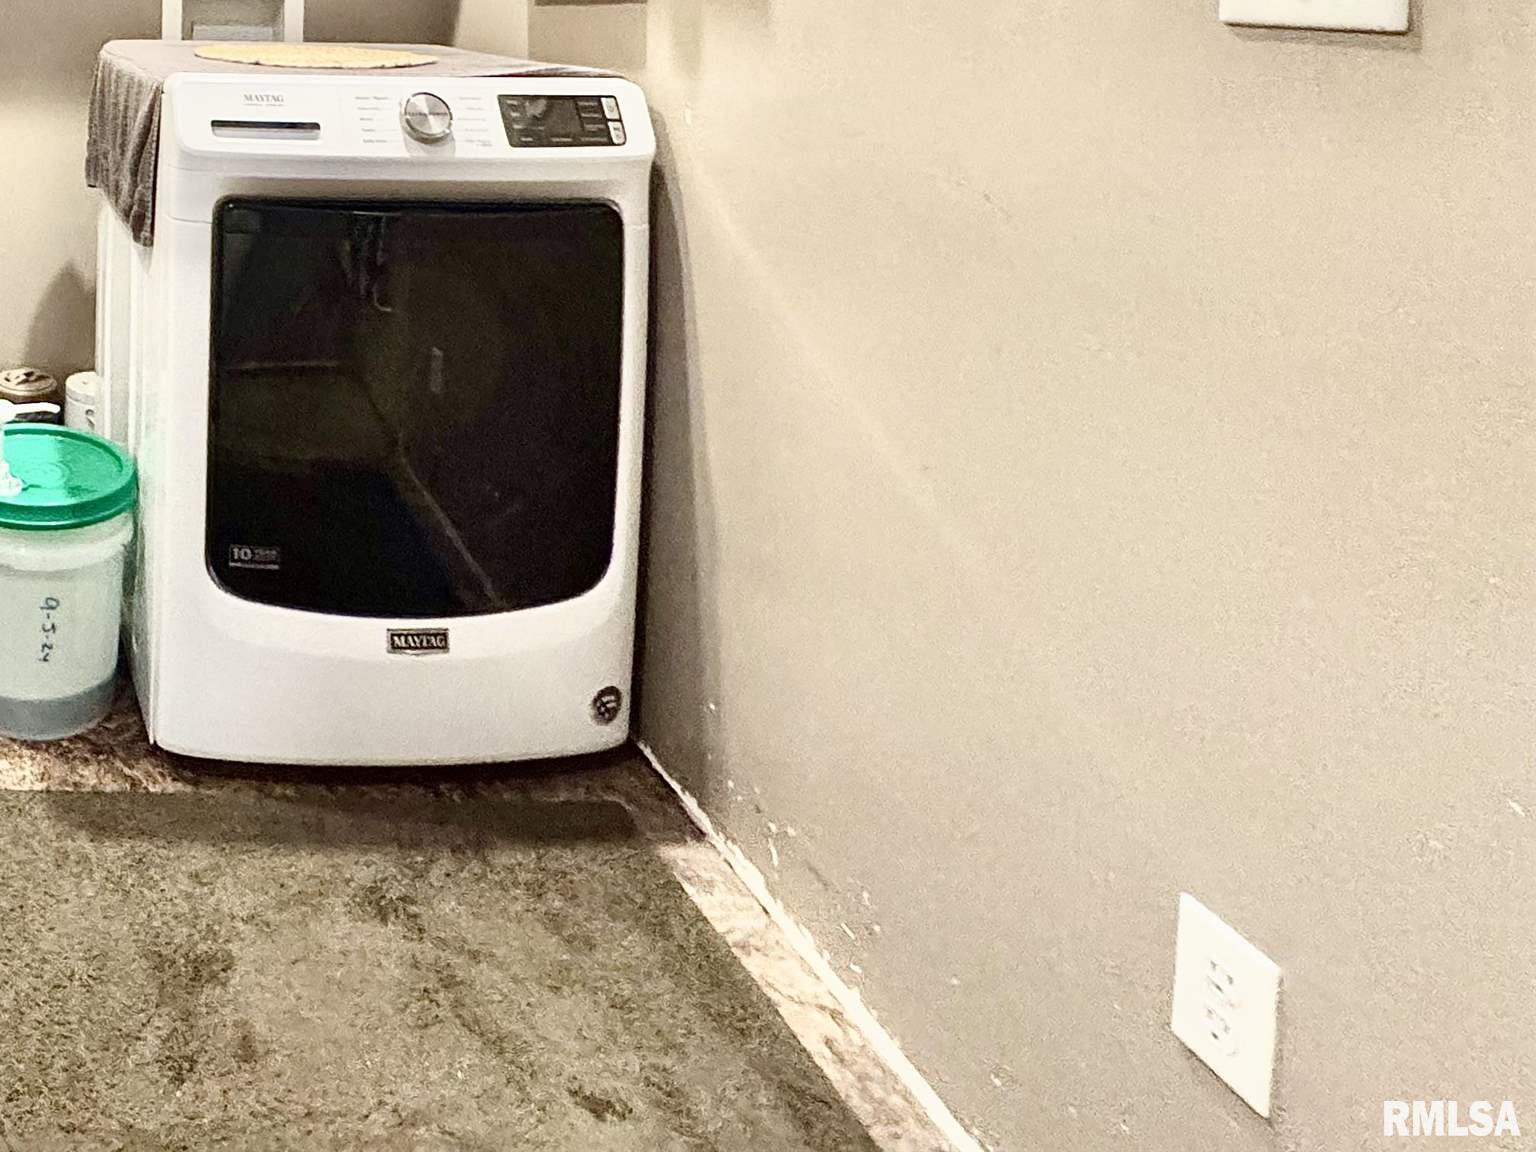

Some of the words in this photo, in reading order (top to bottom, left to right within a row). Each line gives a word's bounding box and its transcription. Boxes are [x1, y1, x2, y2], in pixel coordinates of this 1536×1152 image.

[243, 93, 285, 103] MAYTAG
[232, 548, 252, 560] 10
[393, 635, 446, 648] MAYTAG
